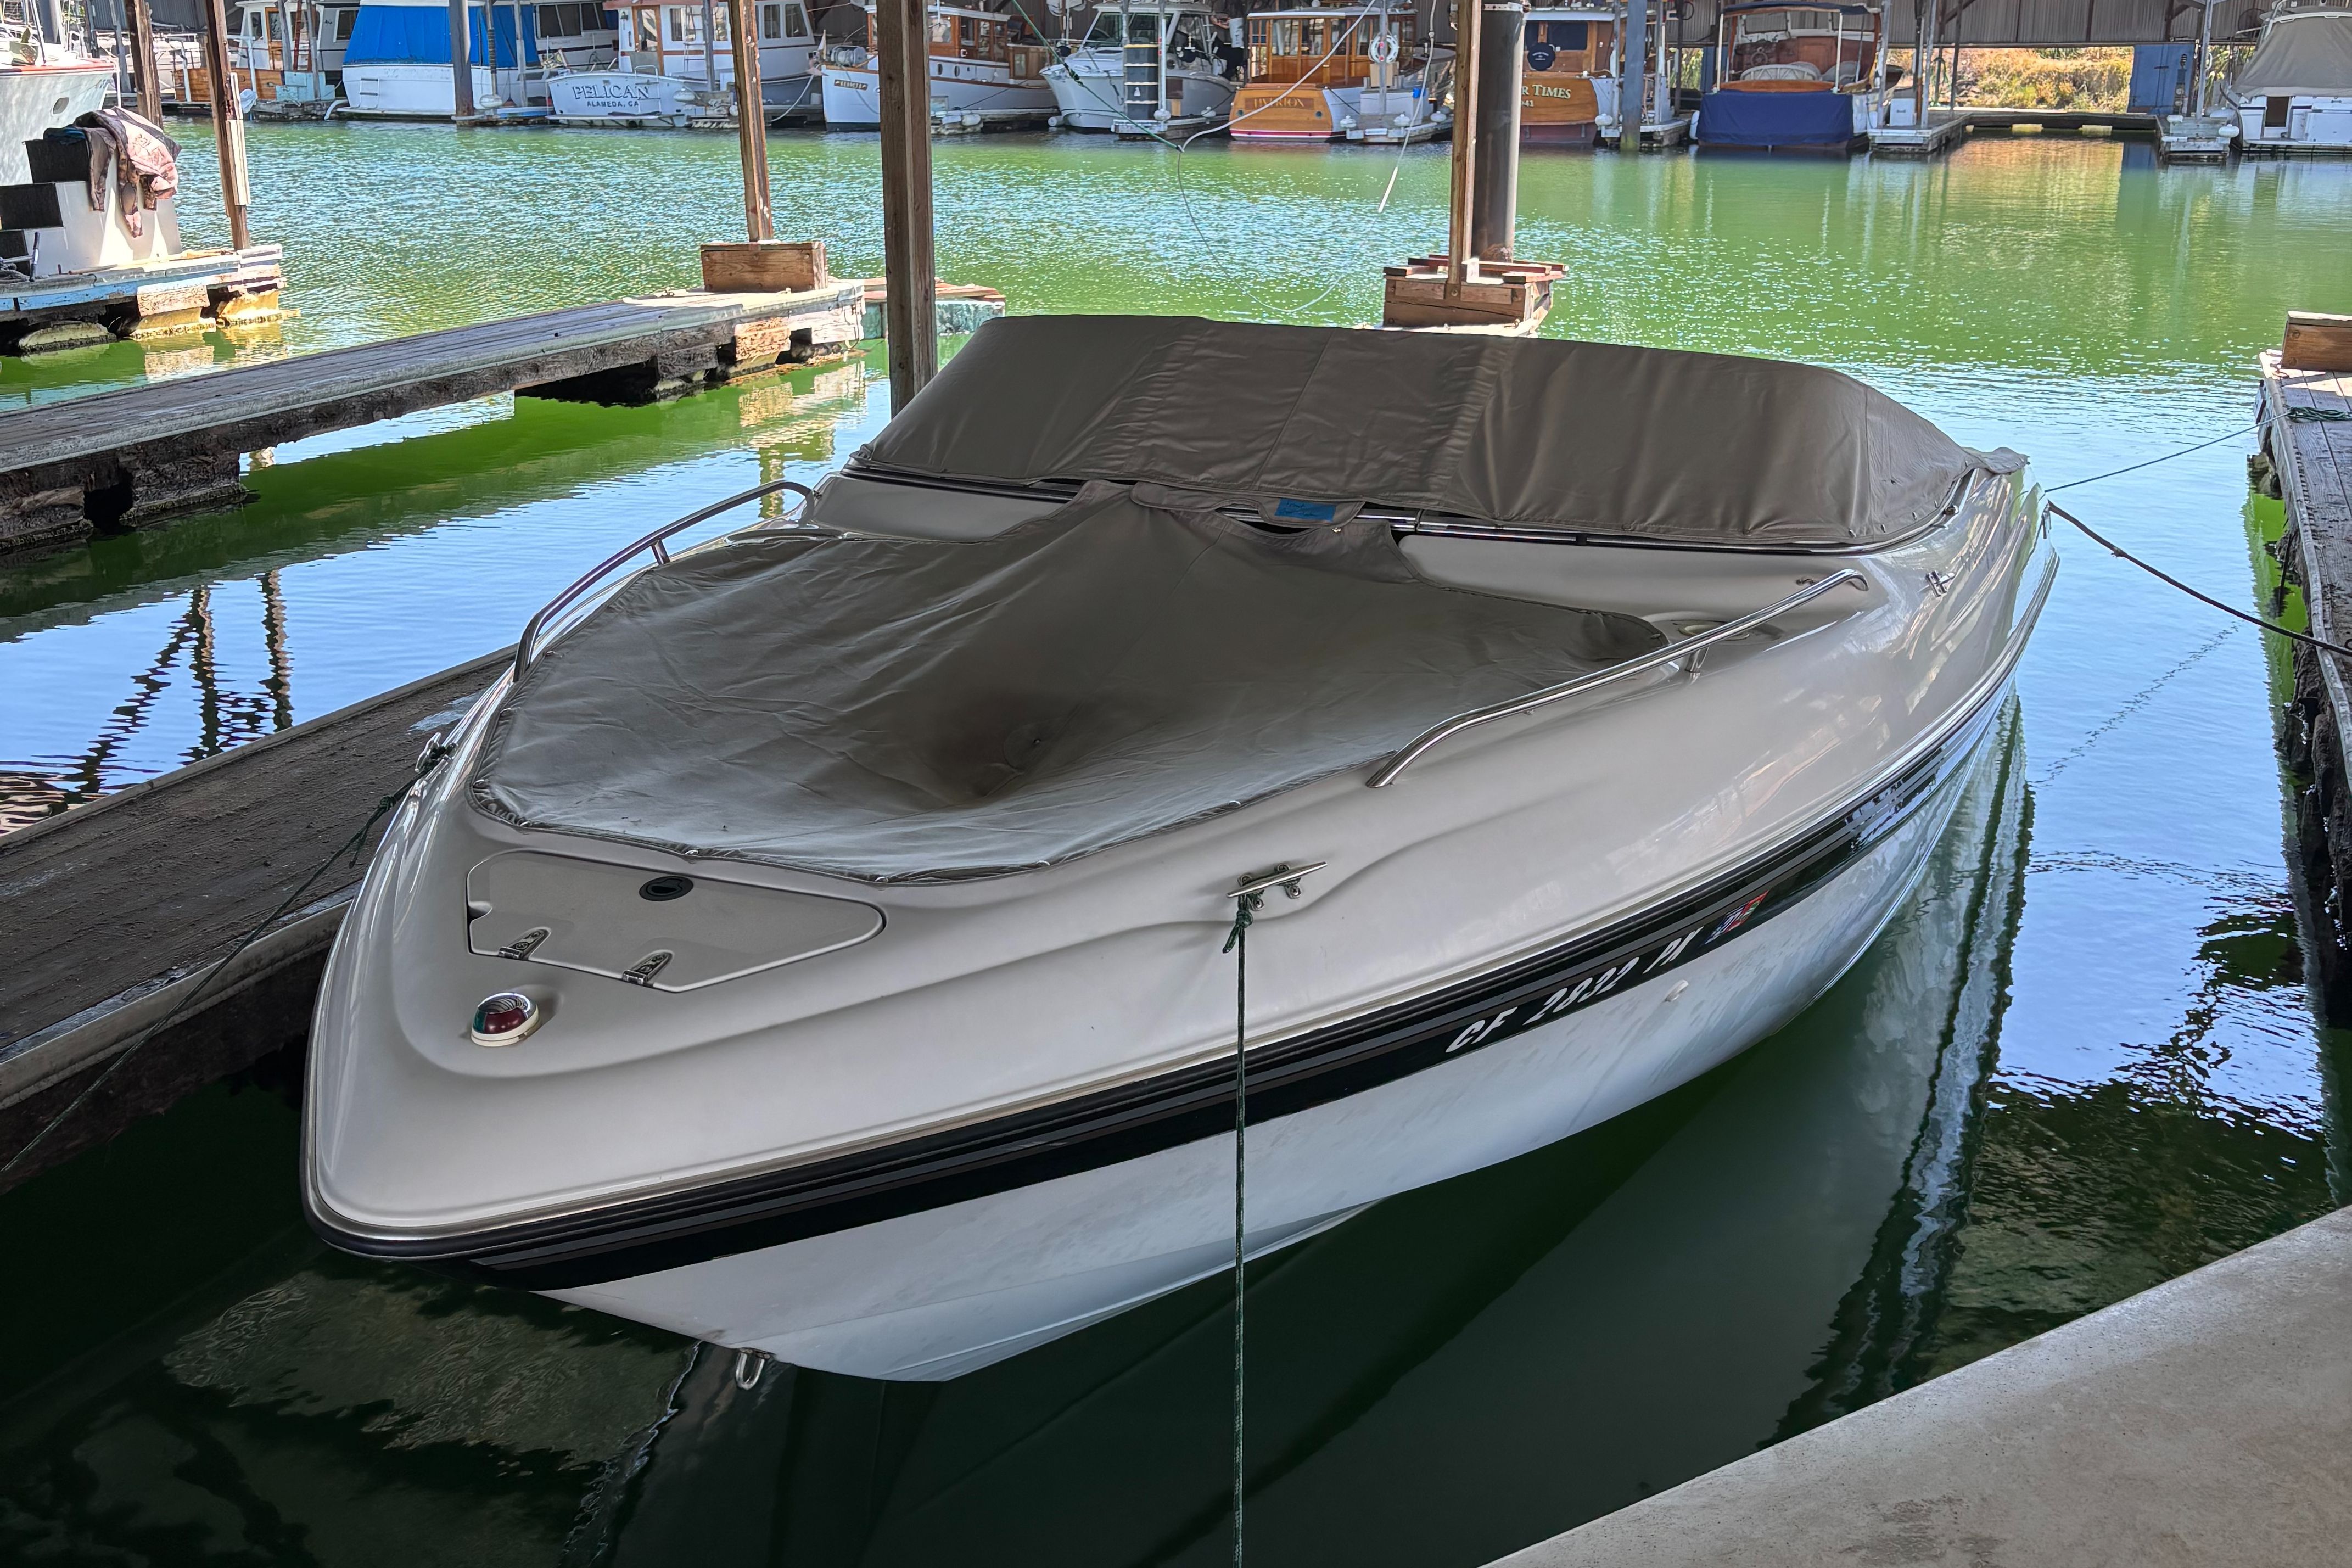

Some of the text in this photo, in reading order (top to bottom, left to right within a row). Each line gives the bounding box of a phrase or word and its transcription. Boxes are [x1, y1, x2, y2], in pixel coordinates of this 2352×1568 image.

[573, 85, 649, 100] PELICAN
[1532, 85, 1572, 99] TIMES
[1446, 926, 1704, 1053] CF 2832 PX
